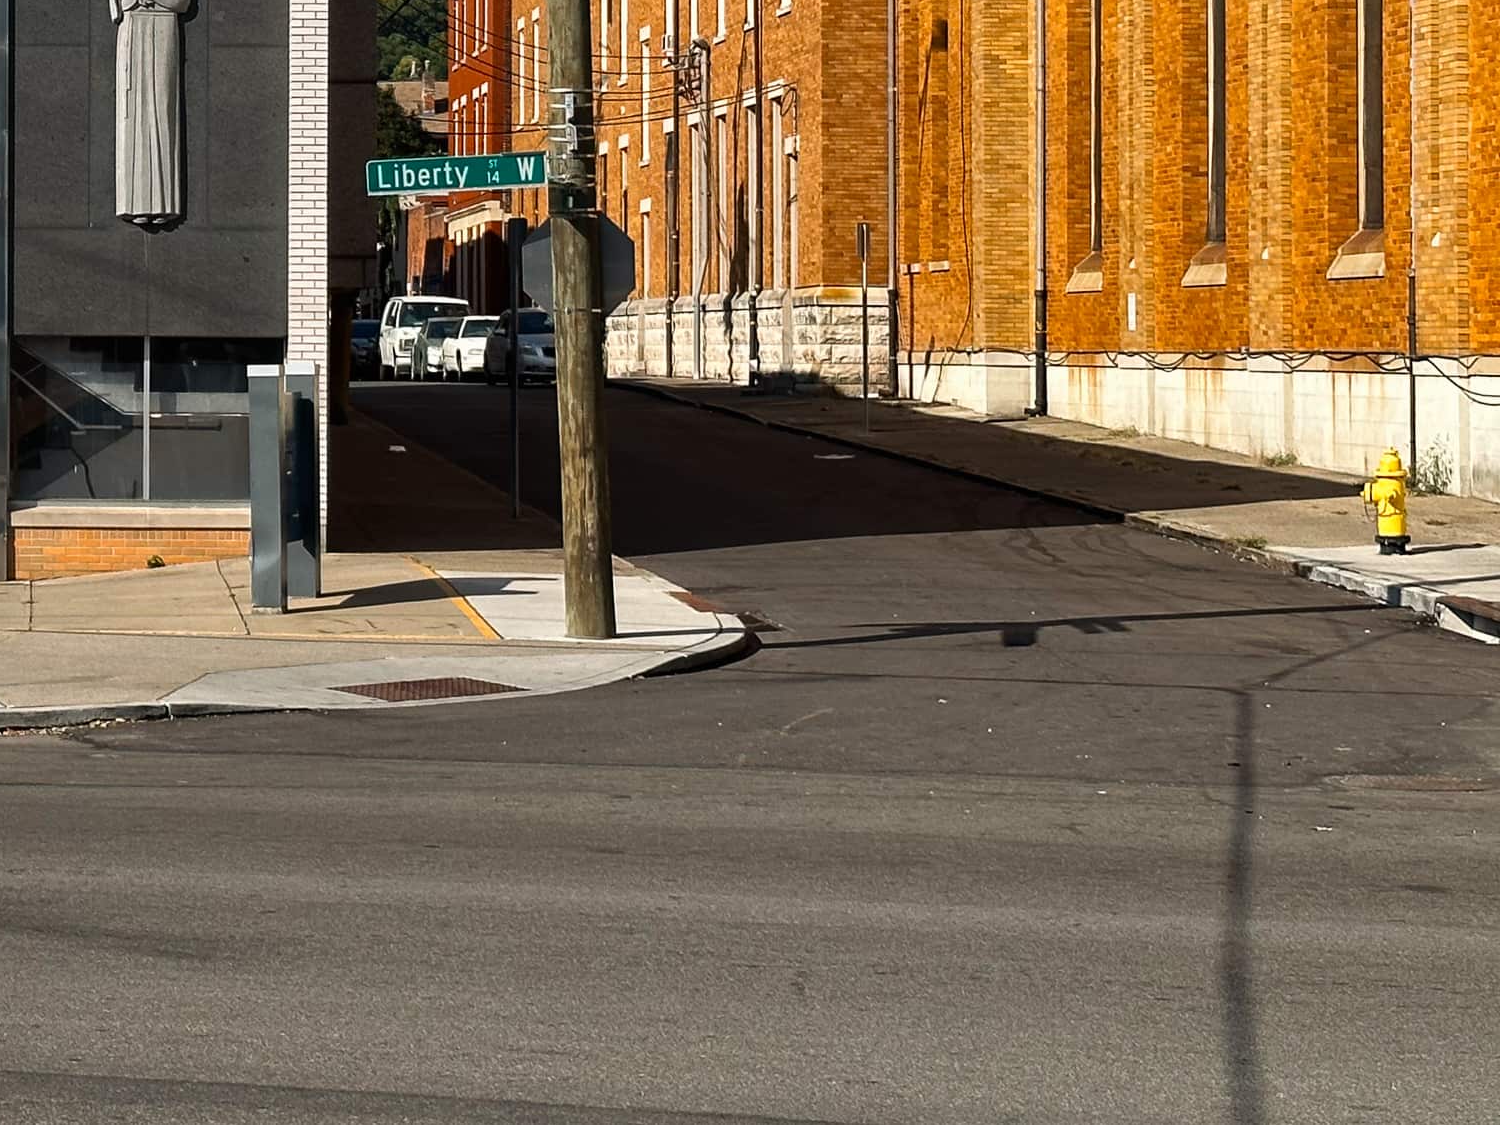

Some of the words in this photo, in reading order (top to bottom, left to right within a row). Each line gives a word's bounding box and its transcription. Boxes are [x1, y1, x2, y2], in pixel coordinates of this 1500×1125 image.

[488, 159, 498, 168] ST
[516, 156, 535, 181] W
[377, 161, 469, 189] Liberty
[486, 170, 500, 184] 14
